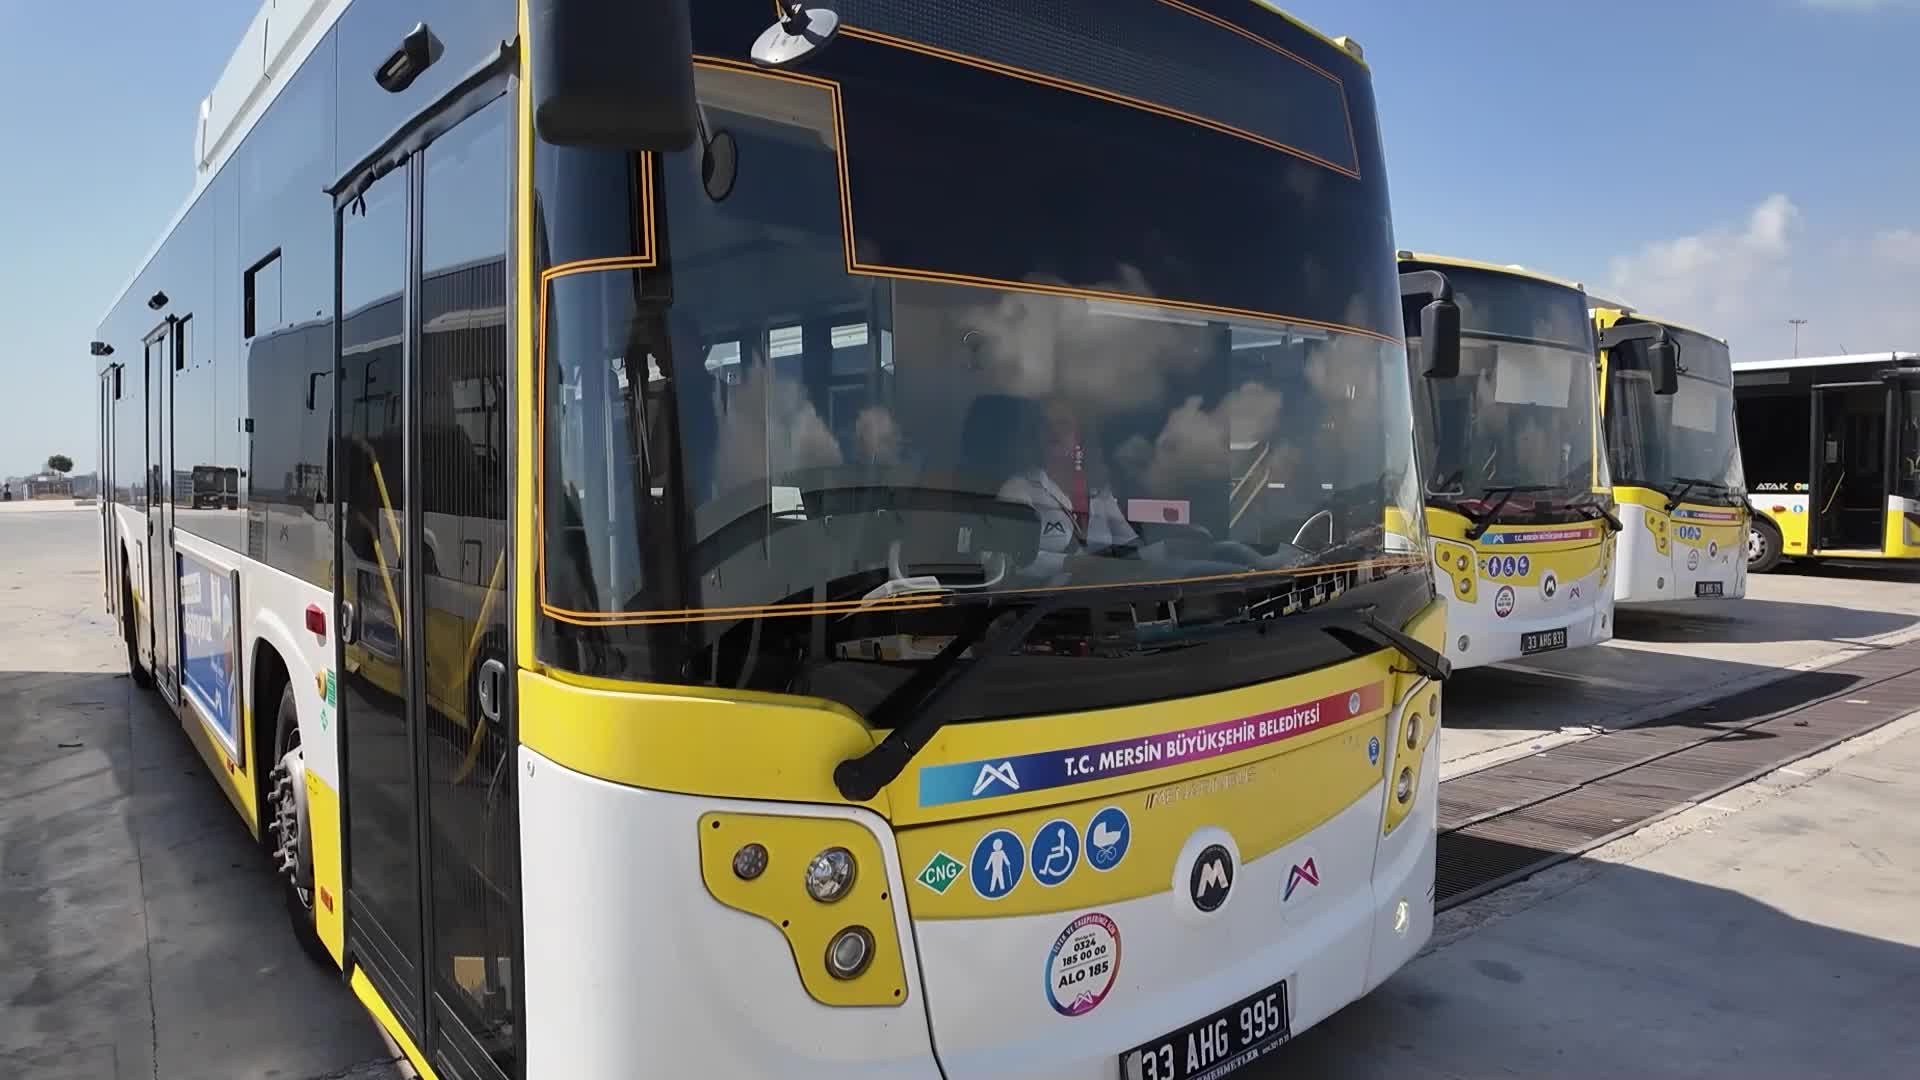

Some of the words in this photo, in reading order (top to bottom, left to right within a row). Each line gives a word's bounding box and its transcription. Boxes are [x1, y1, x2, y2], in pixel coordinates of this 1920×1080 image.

[1755, 482, 1788, 491] ATAK
[1527, 636, 1537, 650] 33
[1553, 631, 1564, 645] 833
[1065, 755, 1094, 776] T.C.
[1099, 740, 1161, 770] MERSİN
[1167, 723, 1255, 756] BÜYÜKŞEHİR
[1259, 703, 1320, 738] BELEDİYESİ
[926, 862, 957, 884] CNG
[1074, 937, 1097, 952] 0324
[1062, 954, 1078, 967] 185
[1080, 950, 1092, 961] 00
[1094, 945, 1107, 956] 00
[1058, 968, 1086, 989] ALO
[1089, 960, 1109, 977] 185
[1142, 1043, 1175, 1080] 33
[1186, 1018, 1229, 1074] AHG
[1240, 993, 1279, 1045] 995
